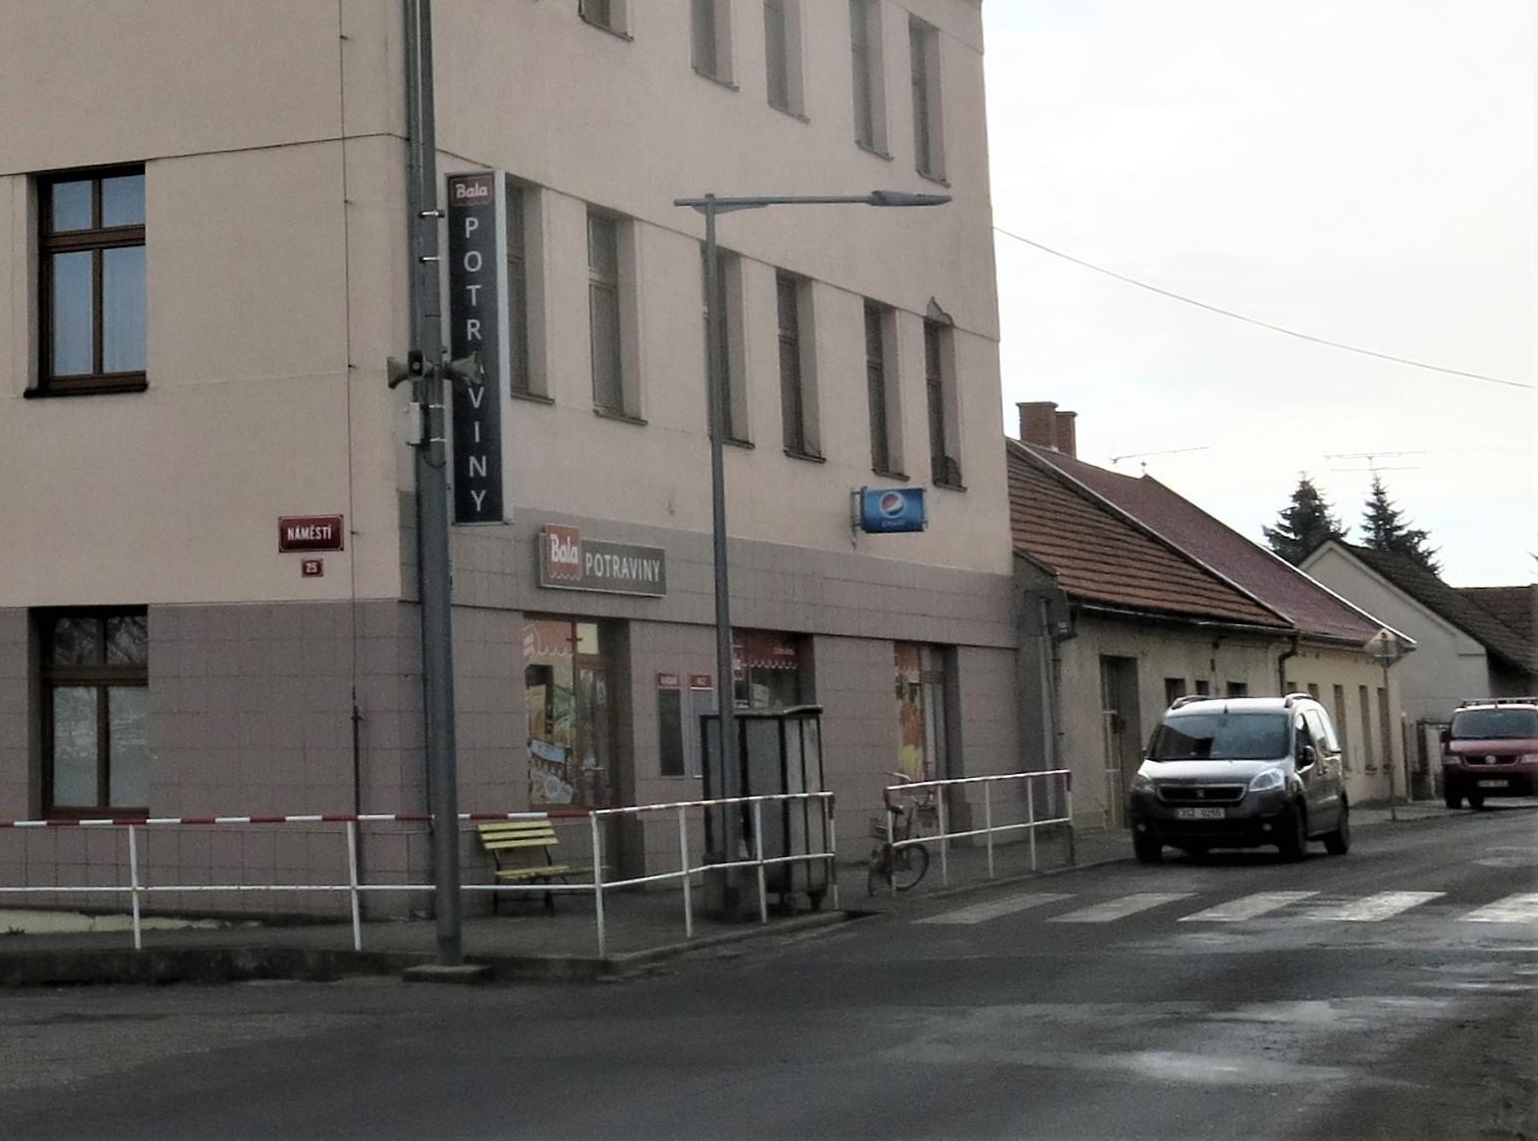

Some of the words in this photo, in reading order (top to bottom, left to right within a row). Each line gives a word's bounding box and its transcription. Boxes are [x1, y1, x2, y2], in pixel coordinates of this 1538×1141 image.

[455, 182, 488, 198] Bala
[463, 217, 486, 512] POTRVINY
[287, 523, 332, 540] NÁMĚSTÍ
[549, 533, 579, 564] Bala
[585, 552, 661, 582] POTRAVINY
